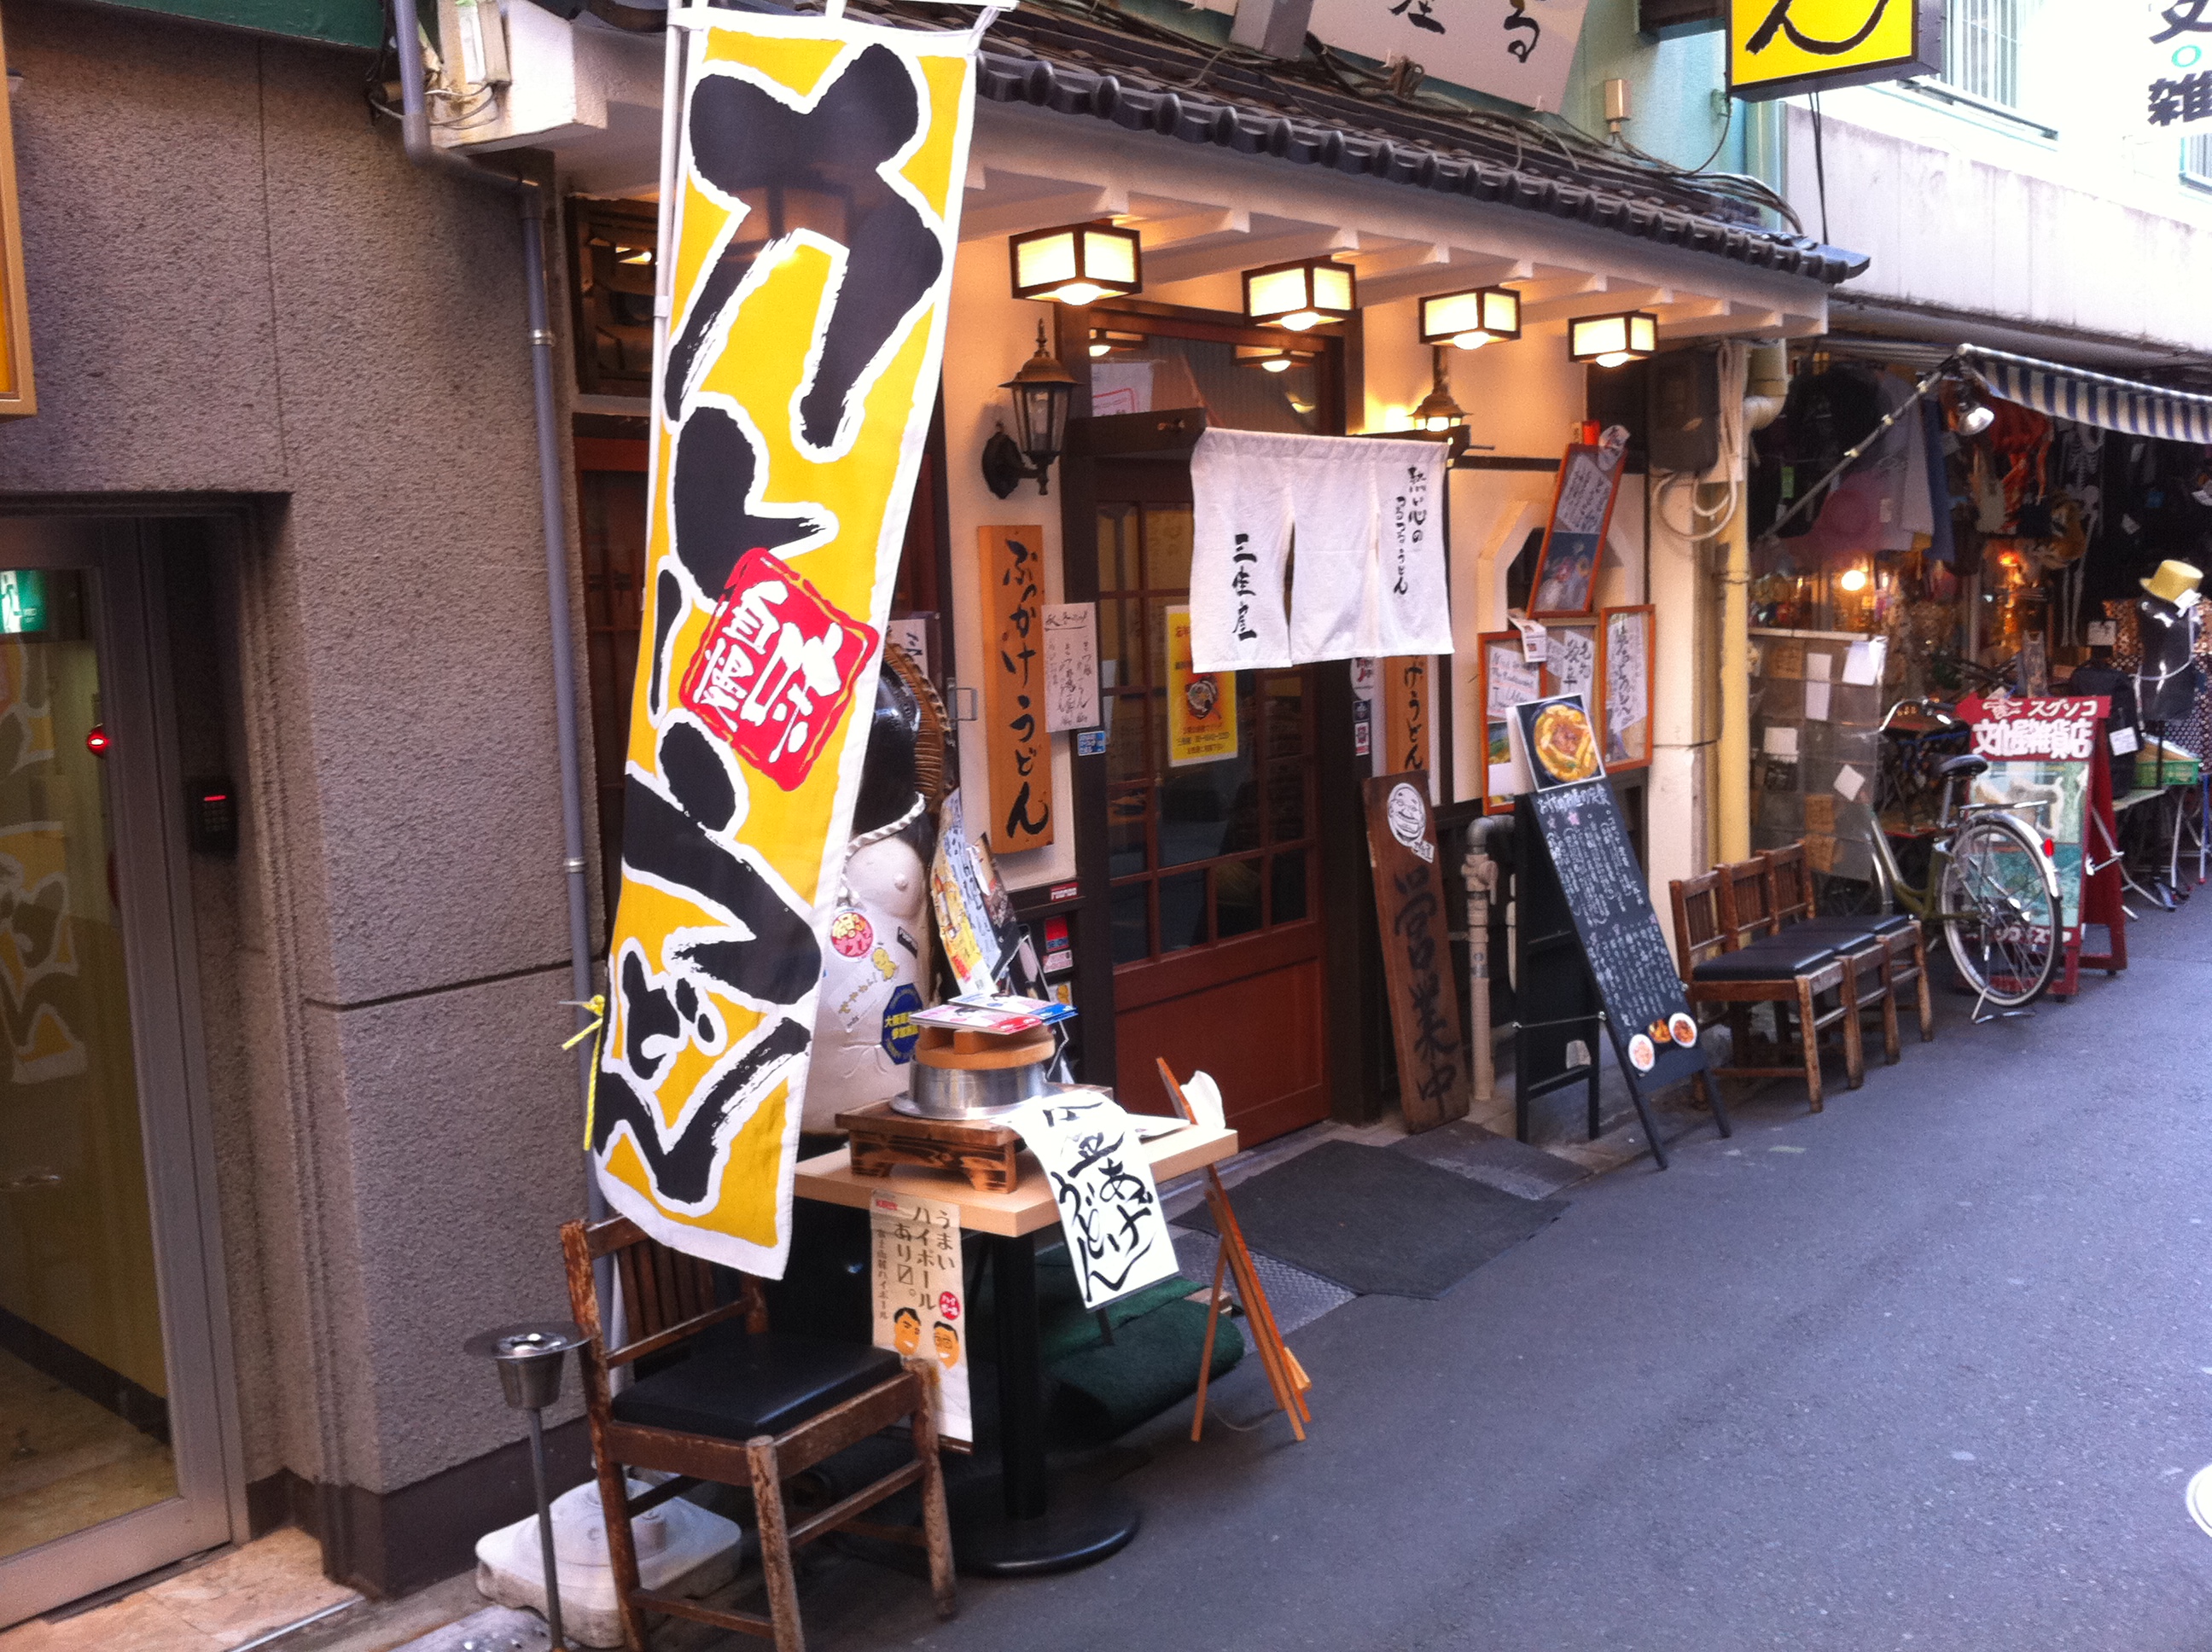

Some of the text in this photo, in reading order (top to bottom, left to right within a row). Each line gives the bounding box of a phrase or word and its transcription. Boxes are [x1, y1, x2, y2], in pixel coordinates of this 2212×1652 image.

[595, 43, 945, 1205] カレーうどん
[694, 580, 789, 732] 自慢
[740, 621, 843, 763] 味
[1002, 538, 1050, 839] ぶっかけうどん
[1971, 717, 2094, 759] 文化屋雑貨店
[2028, 698, 2098, 718] スグソコ
[1392, 864, 1459, 1120] 営業中
[912, 1206, 937, 1311] ハイボール
[936, 1210, 956, 1271] うまい
